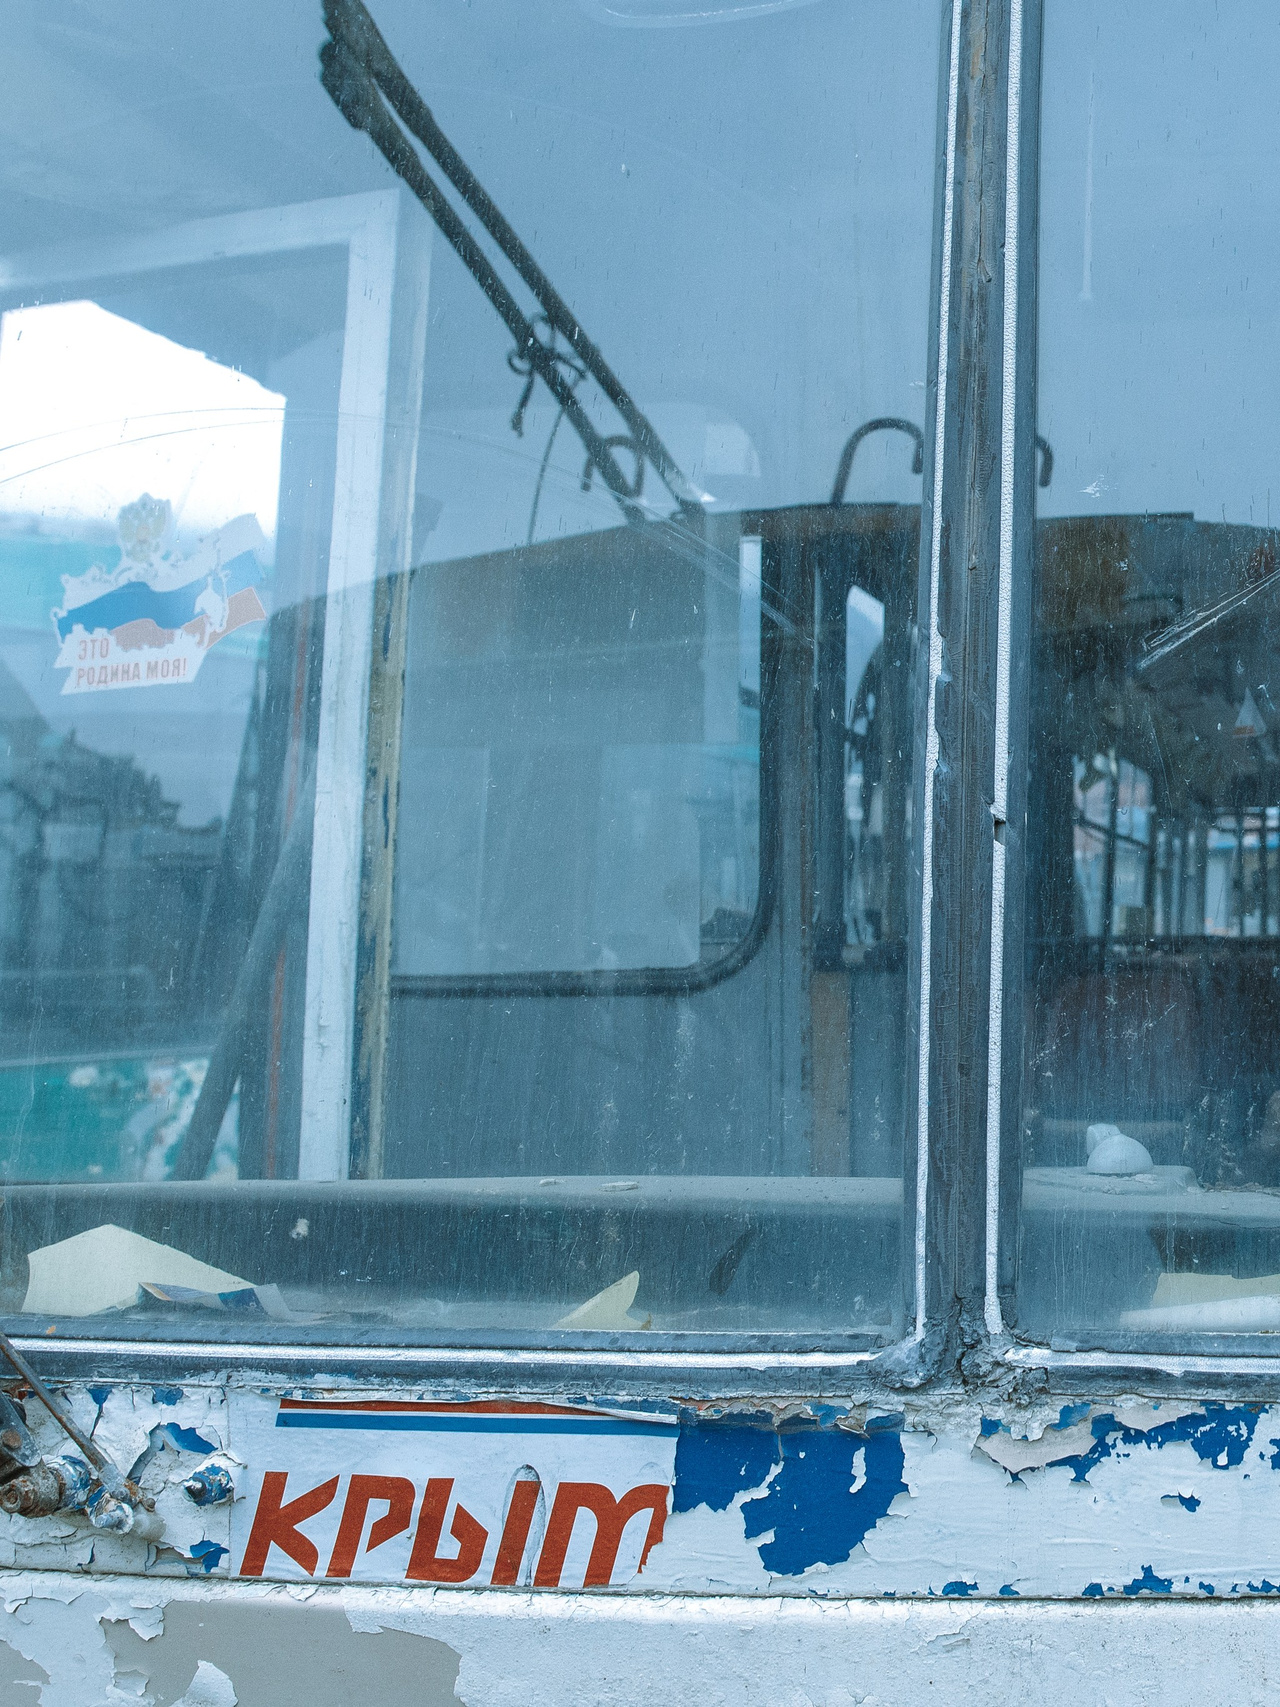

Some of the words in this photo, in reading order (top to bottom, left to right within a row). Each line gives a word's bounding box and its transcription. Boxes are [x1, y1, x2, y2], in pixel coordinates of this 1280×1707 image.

[79, 638, 109, 660] ЭТО
[77, 662, 140, 686] РОДИНА
[146, 658, 187, 679] МОЯ!
[239, 1471, 670, 1588] КРЫМ
